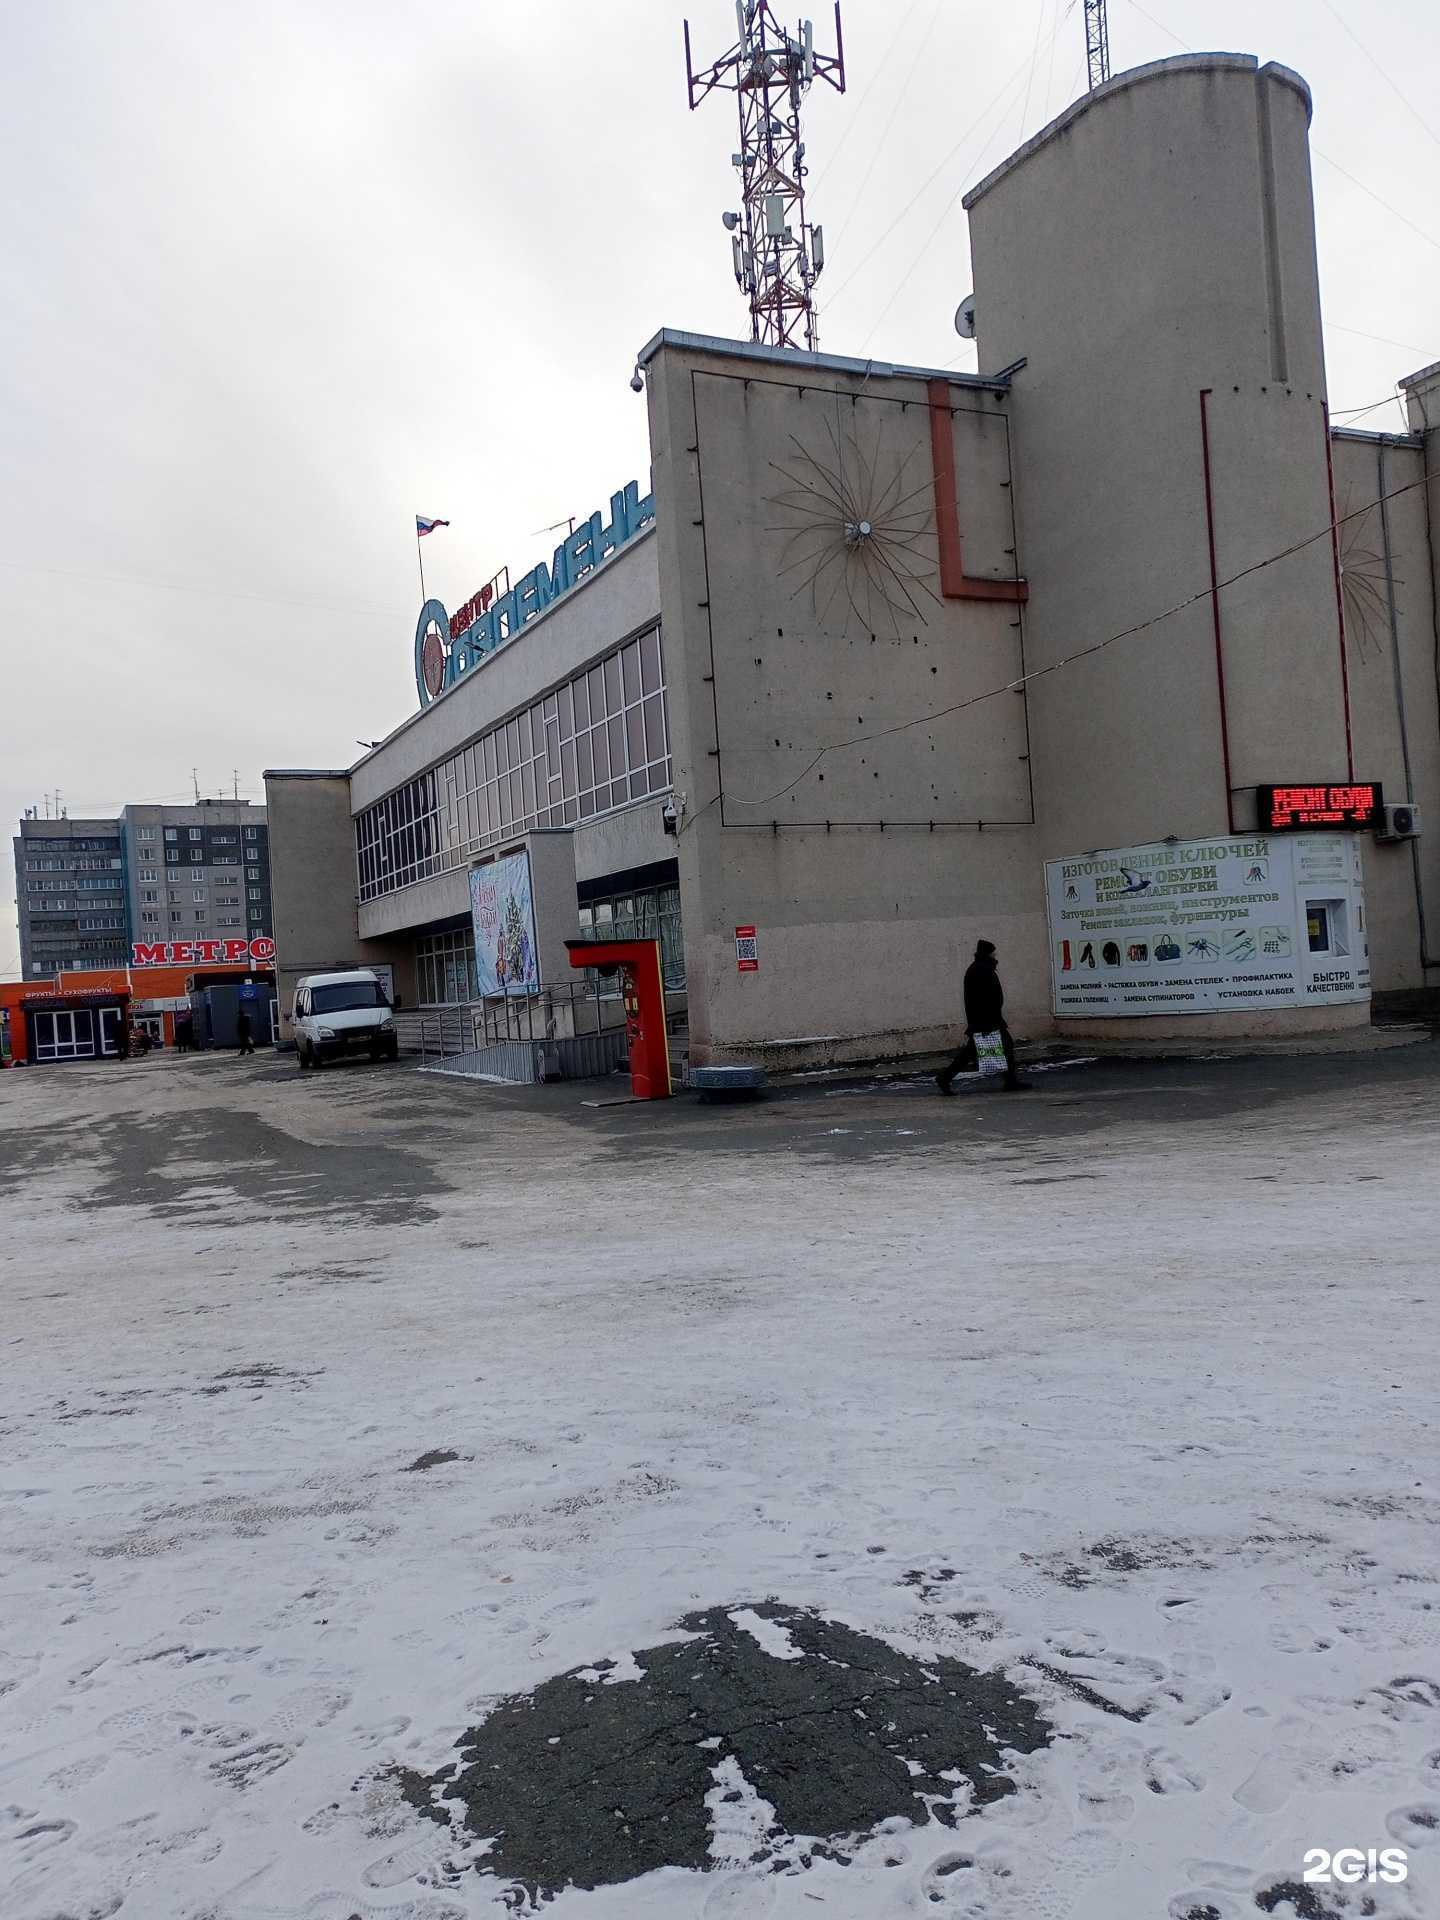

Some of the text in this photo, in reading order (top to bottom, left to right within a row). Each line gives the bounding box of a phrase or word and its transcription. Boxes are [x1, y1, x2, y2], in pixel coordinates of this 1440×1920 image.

[1062, 851, 1175, 878] ИЗГОТОВЛЕНИЕ
[1179, 839, 1270, 863] КЛЮЧЕЙ
[1156, 865, 1218, 883] ОБУВИ
[1061, 909, 1094, 919] Заточка
[1183, 893, 1279, 908] инструментов
[1080, 920, 1112, 930] Ремонт
[1170, 909, 1249, 925] фурнитуры
[132, 937, 275, 965] МЕТРО
[1232, 973, 1293, 983] ПРОФИЛАКТИКА
[1313, 971, 1350, 982] БЫСТРО
[1149, 993, 1195, 1001] СУПИНАТОРОВ
[1218, 990, 1263, 998] УСТАНОВКА
[1265, 987, 1295, 995] НАБОЕК
[1306, 982, 1354, 993] КАЧЕСТВЕННО
